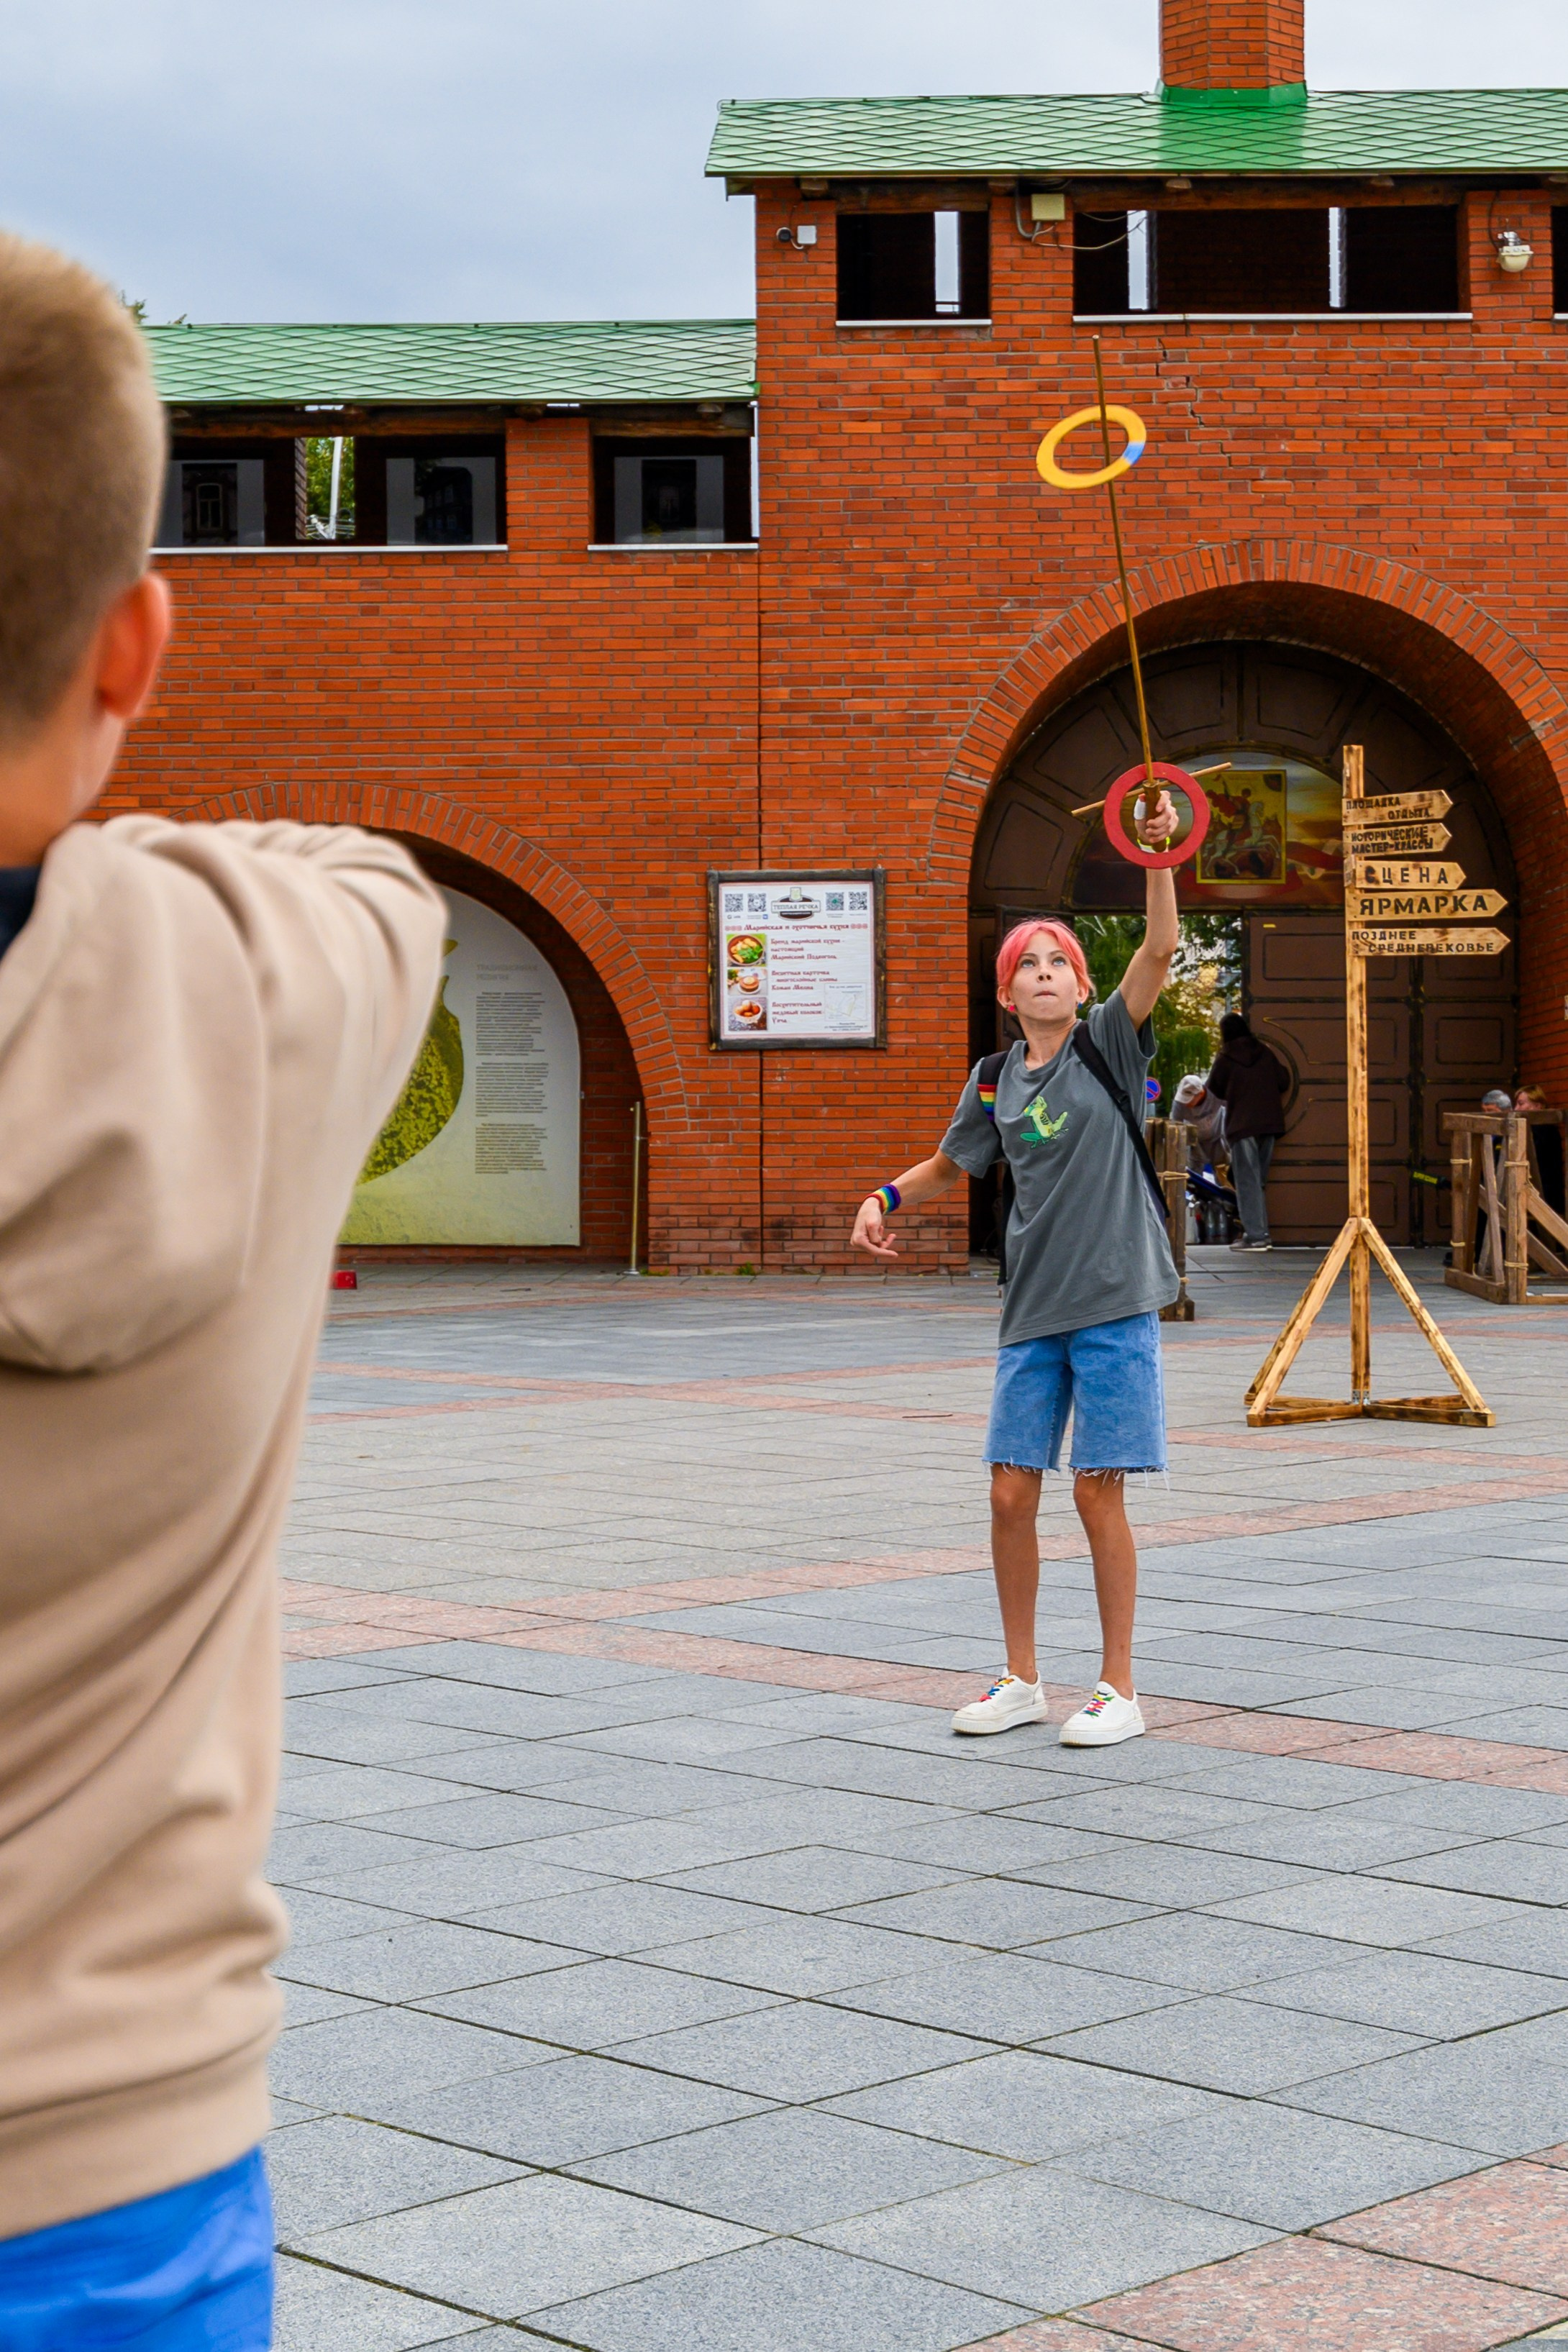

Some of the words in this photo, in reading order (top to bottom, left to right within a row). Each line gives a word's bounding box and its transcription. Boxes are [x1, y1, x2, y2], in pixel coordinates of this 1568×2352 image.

[1346, 797, 1400, 809] ПЛОЩАДКА
[1352, 826, 1428, 842] ИСТОРИЧЕСКИЕ
[1352, 838, 1433, 854] МАСТЕР-КЛАССЫ
[1365, 865, 1449, 884] СЦЕНА
[1359, 895, 1488, 915] ЯРМАРКА
[1352, 930, 1416, 940] ПОЗДНЕЕ
[1368, 942, 1494, 954] СРЕДНЕВЕКОВЬЕ
